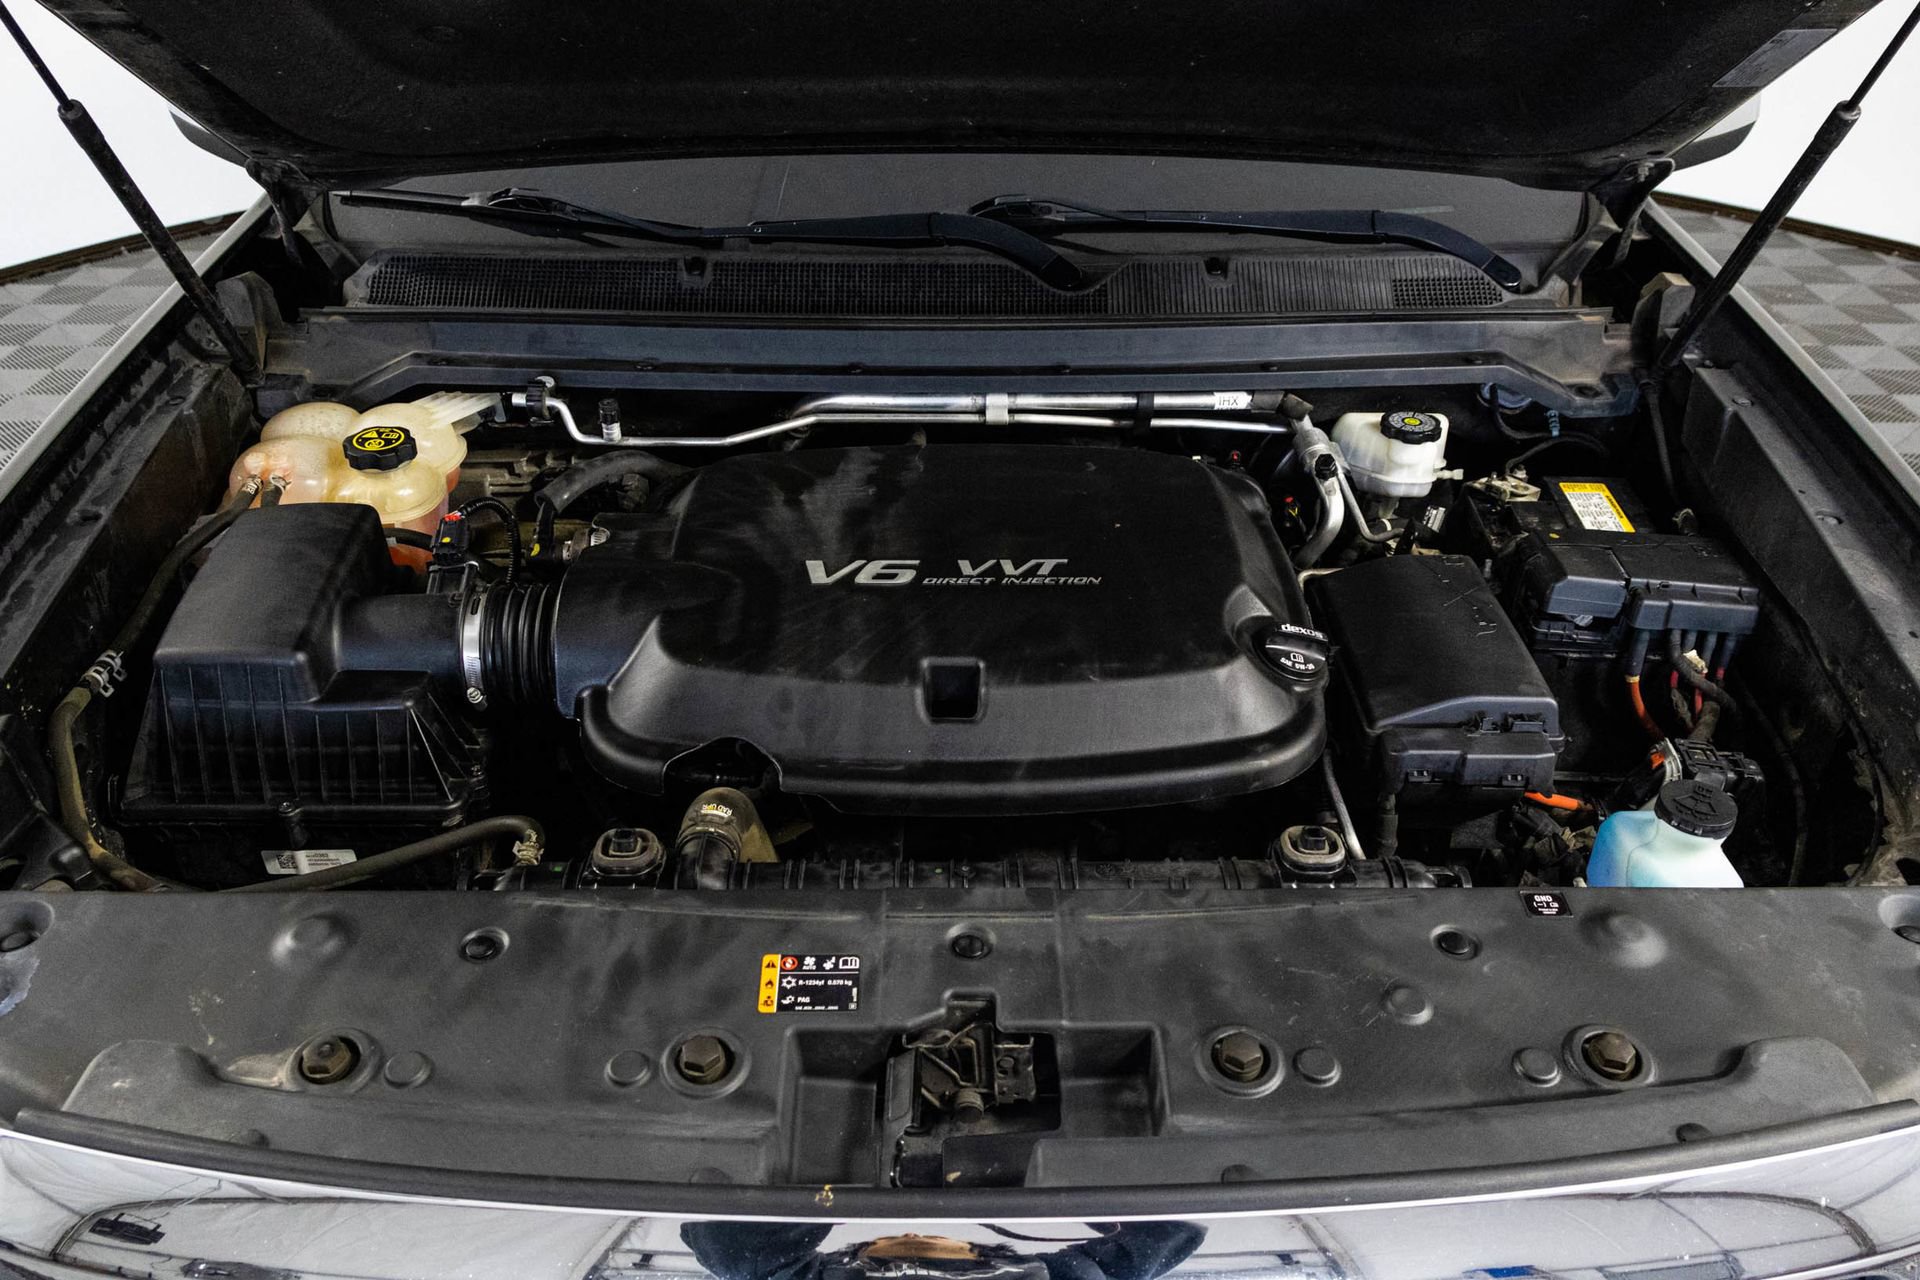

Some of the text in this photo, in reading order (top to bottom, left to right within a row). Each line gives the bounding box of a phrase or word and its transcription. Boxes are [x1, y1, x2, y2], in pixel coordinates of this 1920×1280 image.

[805, 559, 921, 585] V6
[957, 558, 1069, 576] VVT
[922, 576, 1103, 585] DIRECT INJECTION
[1281, 623, 1324, 639] dexos
[717, 804, 733, 816] RAD
[1533, 894, 1553, 902] GND
[844, 979, 853, 987] kg
